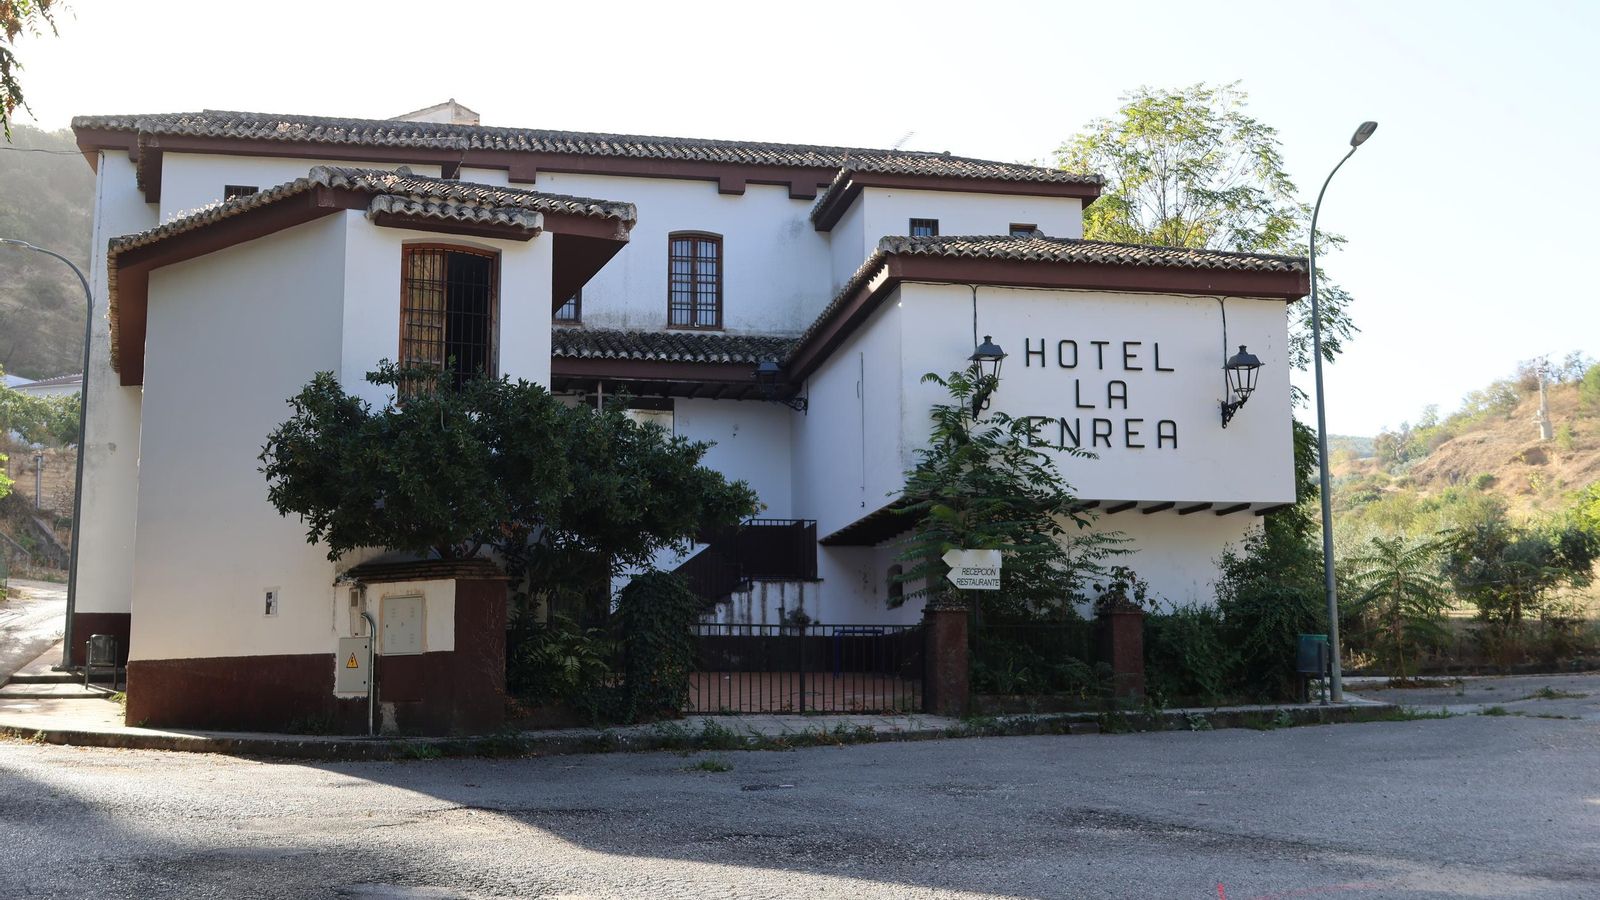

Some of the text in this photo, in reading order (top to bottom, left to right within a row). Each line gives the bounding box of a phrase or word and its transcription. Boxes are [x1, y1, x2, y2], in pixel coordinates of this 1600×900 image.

[1025, 337, 1175, 372] HOTEL
[1075, 379, 1128, 410] LA
[1027, 415, 1178, 449] ENREA
[956, 578, 1000, 587] RESTAURANTE
